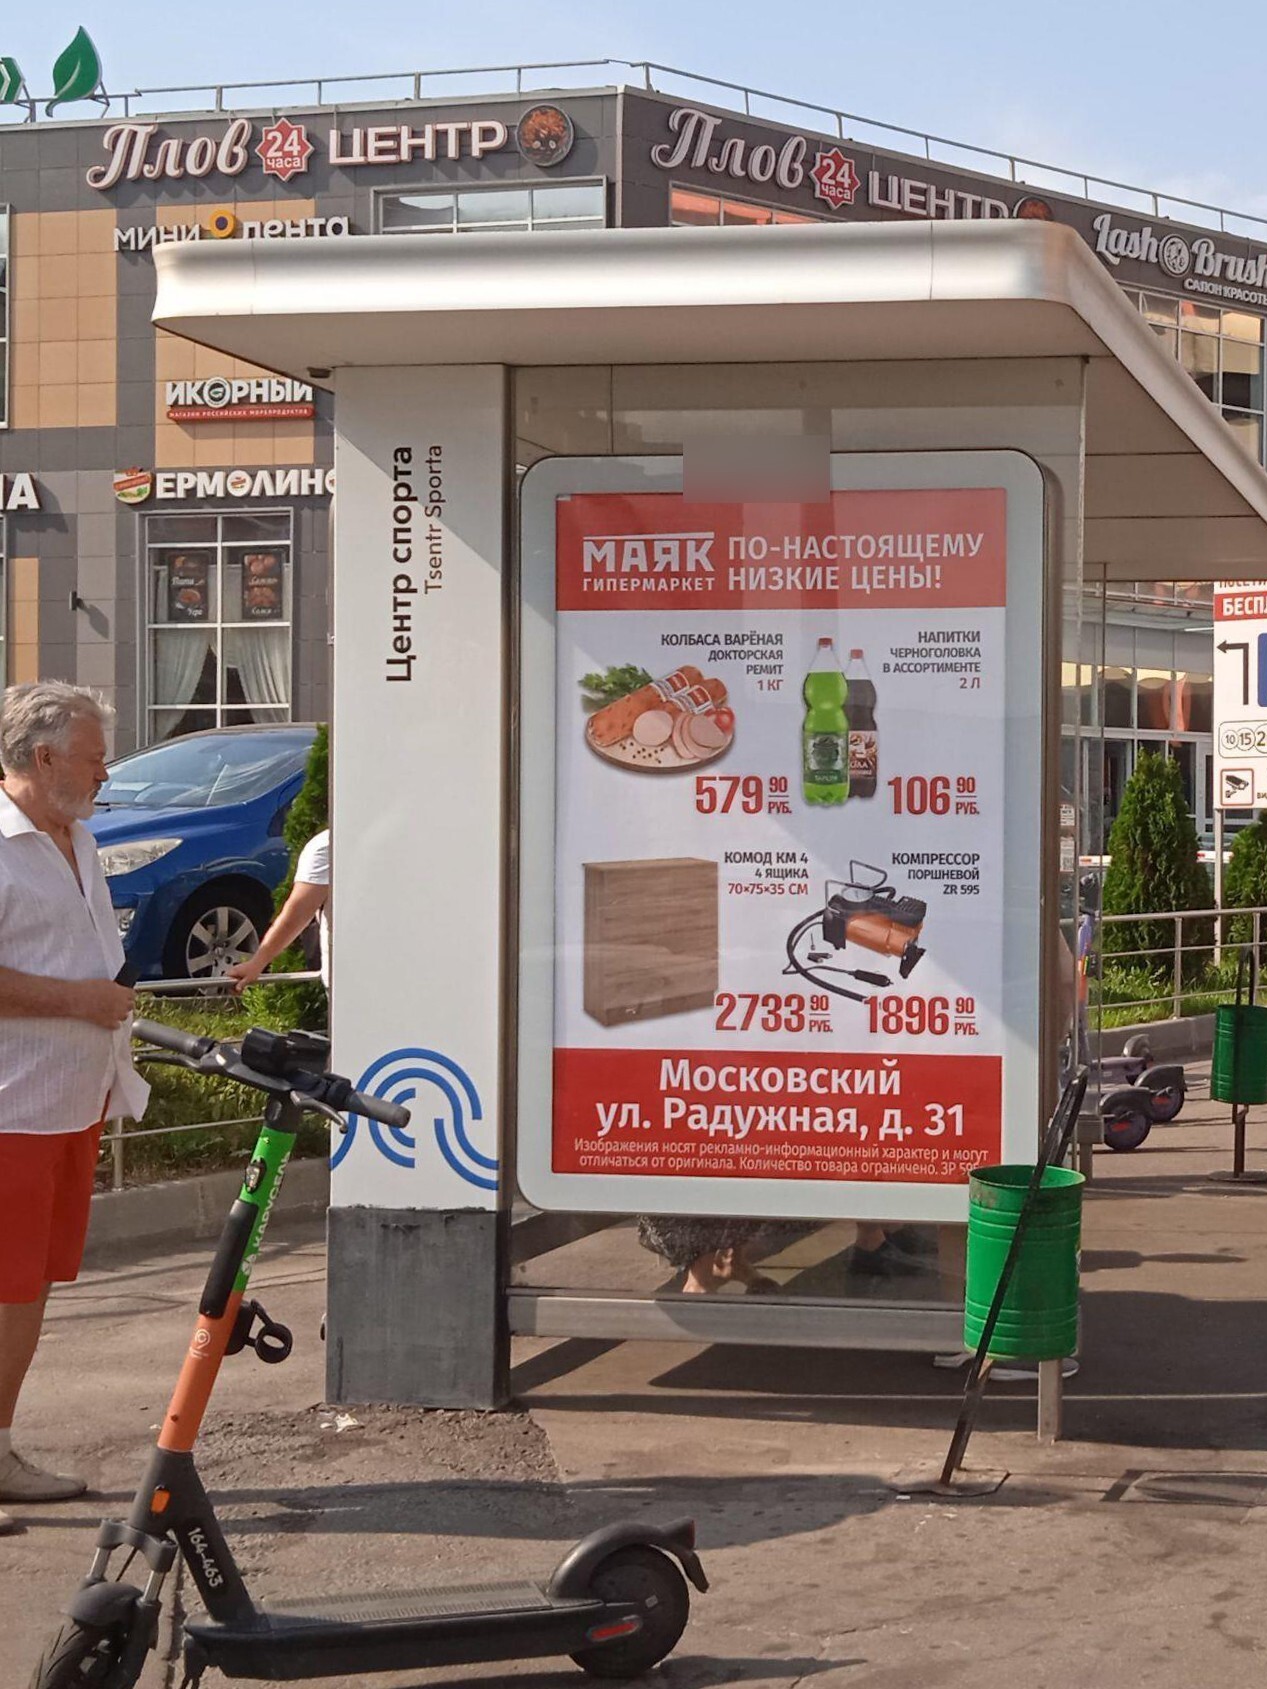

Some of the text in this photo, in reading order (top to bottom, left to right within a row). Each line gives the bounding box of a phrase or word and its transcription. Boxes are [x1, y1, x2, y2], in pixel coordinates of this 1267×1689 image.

[266, 130, 301, 157] 24
[329, 120, 508, 165] ЦЕНТР
[651, 107, 807, 188] Плов
[86, 119, 253, 190] Плов
[265, 157, 301, 168] часа
[821, 159, 851, 187] 24
[821, 184, 851, 200] часа
[1093, 213, 1159, 266] Lash
[1184, 278, 1222, 297] САЛОН
[0, 472, 40, 510] А
[424, 445, 446, 595] Tsentr Sporta
[583, 532, 714, 572] МАЯК
[728, 532, 984, 562] ПО-НАСТОЯЩЕМУ
[386, 447, 418, 682] Центр спорта
[583, 577, 714, 592] ГИПЕРМАРКЕТ
[728, 564, 942, 594] НИЗКИЕ ЦЕНЫ!
[661, 630, 783, 646] КОЛБАСА ВАРЁНАЯ
[918, 631, 981, 643] НАПИТКИ
[708, 648, 783, 662] ДОКТОРСКАЯ
[890, 647, 981, 659] ЧЕРНОГОЛОВКА
[746, 664, 783, 675] РЕМИТ
[883, 661, 981, 674] В АССОРТИМЕНТЕ
[757, 679, 784, 691] 1 КГ
[960, 677, 981, 689] 2 Л
[1225, 734, 1235, 744] 10
[1240, 733, 1252, 745] 15
[769, 777, 788, 793] 90
[957, 777, 976, 793] 90
[696, 775, 764, 814] 579
[887, 775, 949, 815] 106
[768, 800, 792, 815] РУБ.
[956, 801, 980, 815] РУБ.
[724, 852, 809, 866] КОМОД КМ 4
[892, 853, 980, 865] КОМПРЕССОР
[755, 867, 809, 881] 4 ЯЩИКА
[908, 866, 980, 880] ПОРШНЕВОЙ
[789, 883, 809, 895] СМ
[943, 884, 980, 896] ZR 595
[810, 995, 829, 1011] 90
[955, 998, 975, 1014] 90
[715, 992, 806, 1033] 2733
[864, 995, 949, 1036] 1896
[809, 1018, 833, 1033] РУБ.
[954, 1021, 979, 1036] РУБ.
[659, 1058, 900, 1095] Московский
[596, 1097, 964, 1141] ул. Радужная, д. 31
[574, 1138, 988, 1164] Изображения носят рекламно-информационный характер и могут
[579, 1155, 648, 1167] отличаться
[652, 1157, 665, 1167] от
[667, 1157, 736, 1171] оригинала.
[740, 1157, 812, 1170] Количество
[815, 1161, 858, 1174] товара
[861, 1162, 938, 1176] ограничено.
[188, 1527, 223, 1587] 164-463
